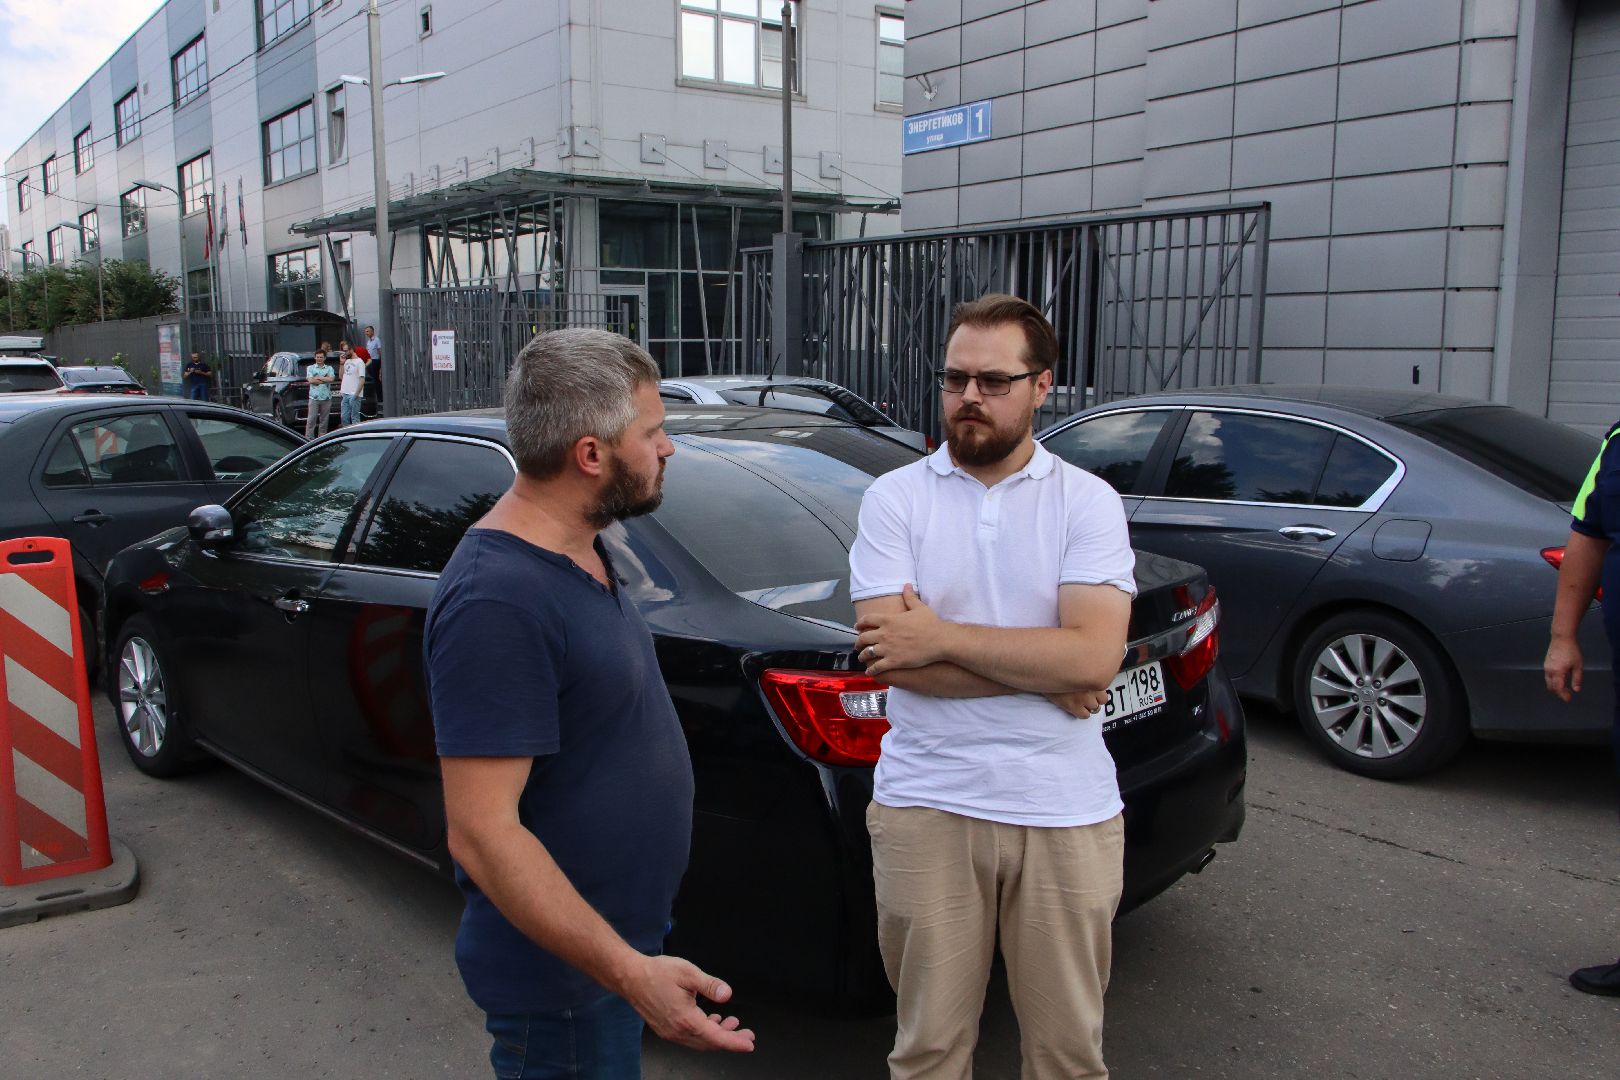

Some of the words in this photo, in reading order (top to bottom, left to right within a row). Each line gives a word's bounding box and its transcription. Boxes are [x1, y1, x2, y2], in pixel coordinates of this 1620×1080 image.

[908, 112, 964, 135] ЭНЕРГЕТИКОВ
[976, 108, 983, 133] 1
[1130, 666, 1159, 697] 198
[1139, 695, 1154, 708] RUS
